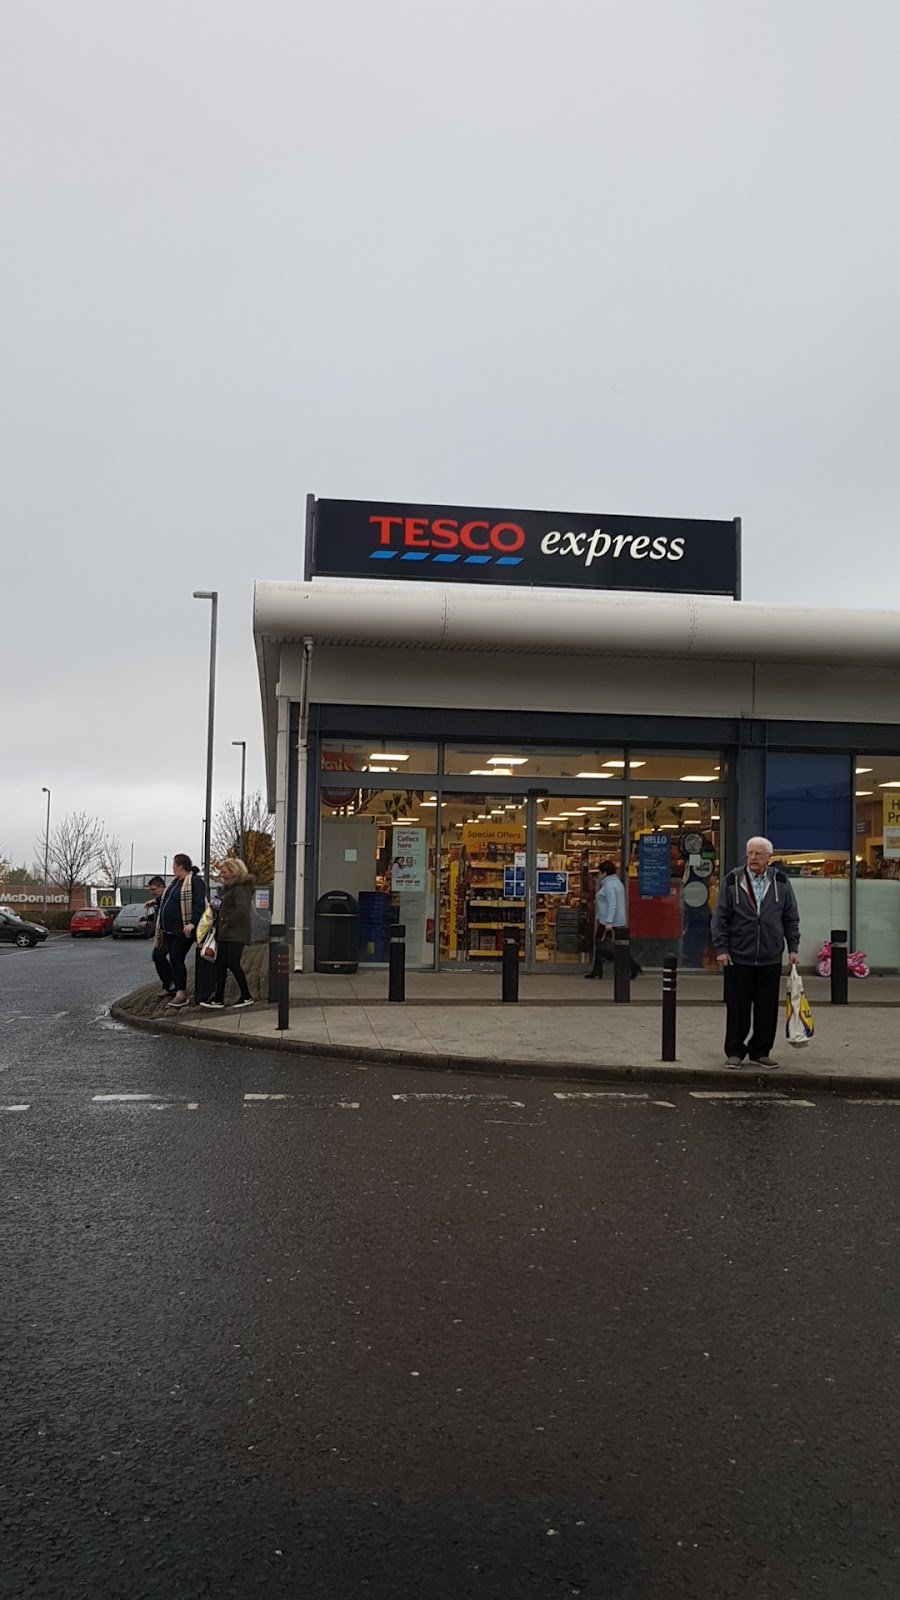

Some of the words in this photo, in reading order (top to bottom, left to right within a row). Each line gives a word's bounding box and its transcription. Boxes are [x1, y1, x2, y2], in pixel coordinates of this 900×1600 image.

[369, 515, 526, 553] TESCO
[540, 527, 686, 567] express
[467, 830, 495, 839] Special
[497, 831, 521, 839] Offers
[643, 835, 667, 844] HELLO
[0, 893, 70, 904] McDonald's
